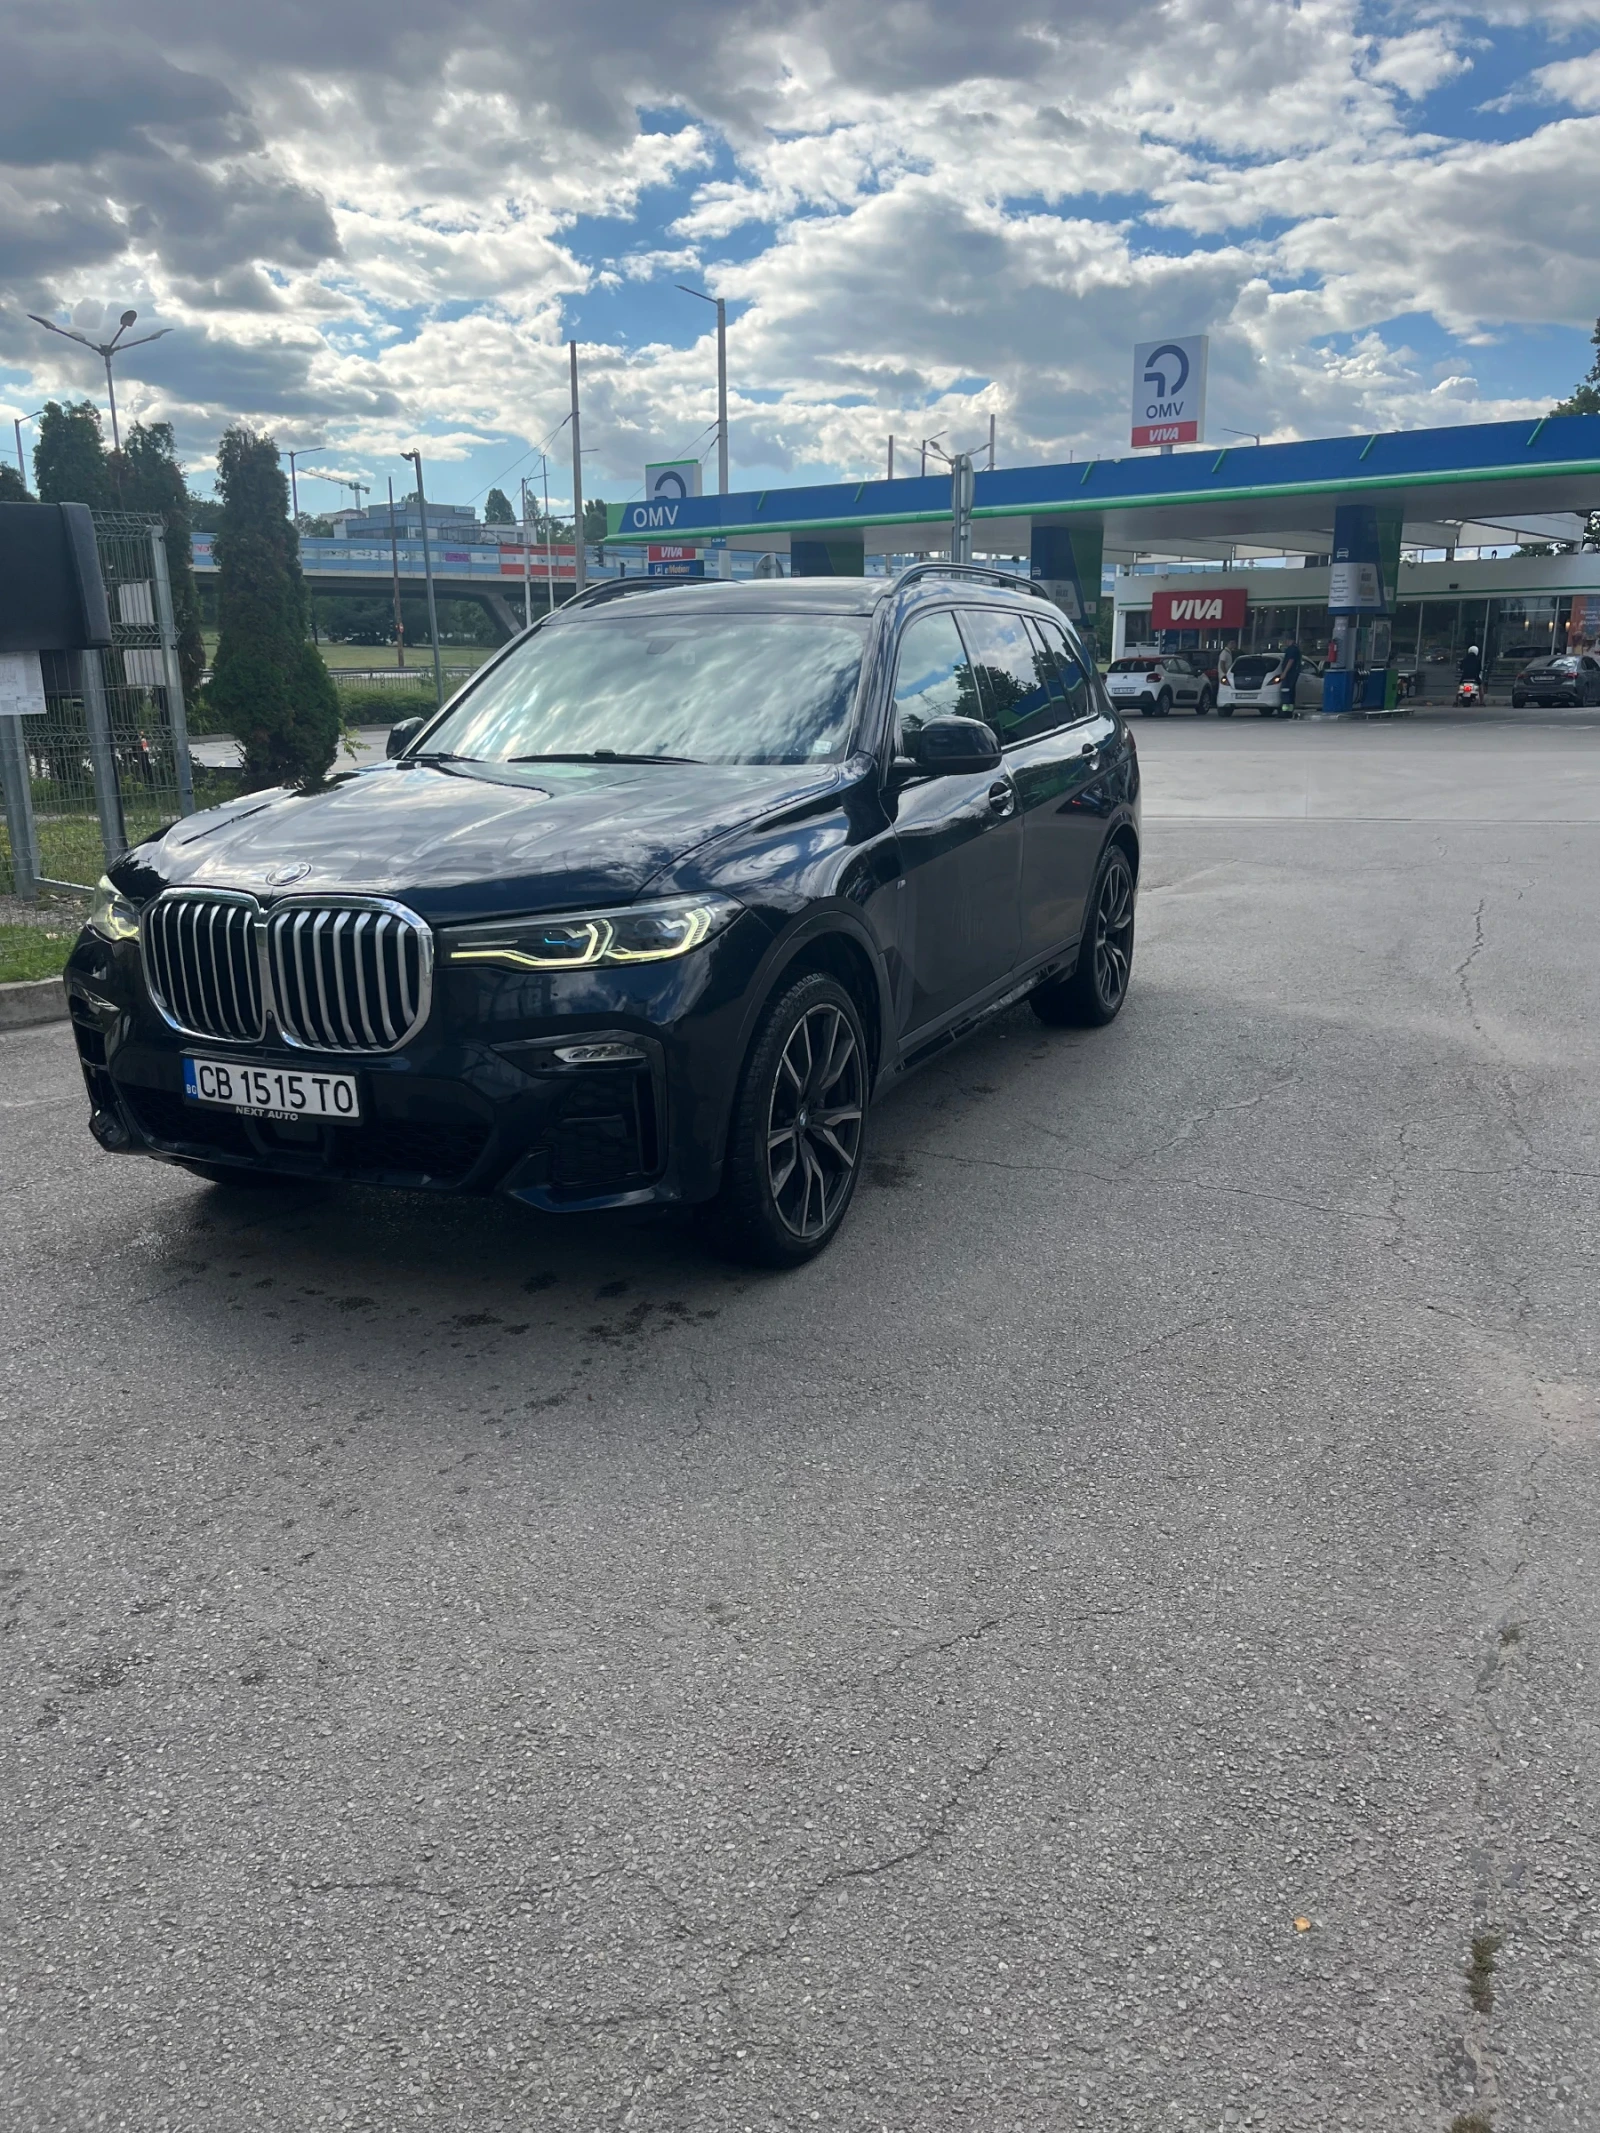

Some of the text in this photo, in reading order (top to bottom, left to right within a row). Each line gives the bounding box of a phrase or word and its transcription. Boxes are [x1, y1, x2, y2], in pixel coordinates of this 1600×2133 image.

[1146, 401, 1184, 419] OMV
[1149, 427, 1179, 442] VIVA
[633, 505, 679, 528] OMV
[661, 546, 683, 558] VIVA
[1171, 599, 1223, 621] VIVA
[186, 1083, 198, 1095] BG
[199, 1066, 233, 1100] CB
[240, 1070, 307, 1110] 1515
[235, 1105, 299, 1122] NEXT AUTO
